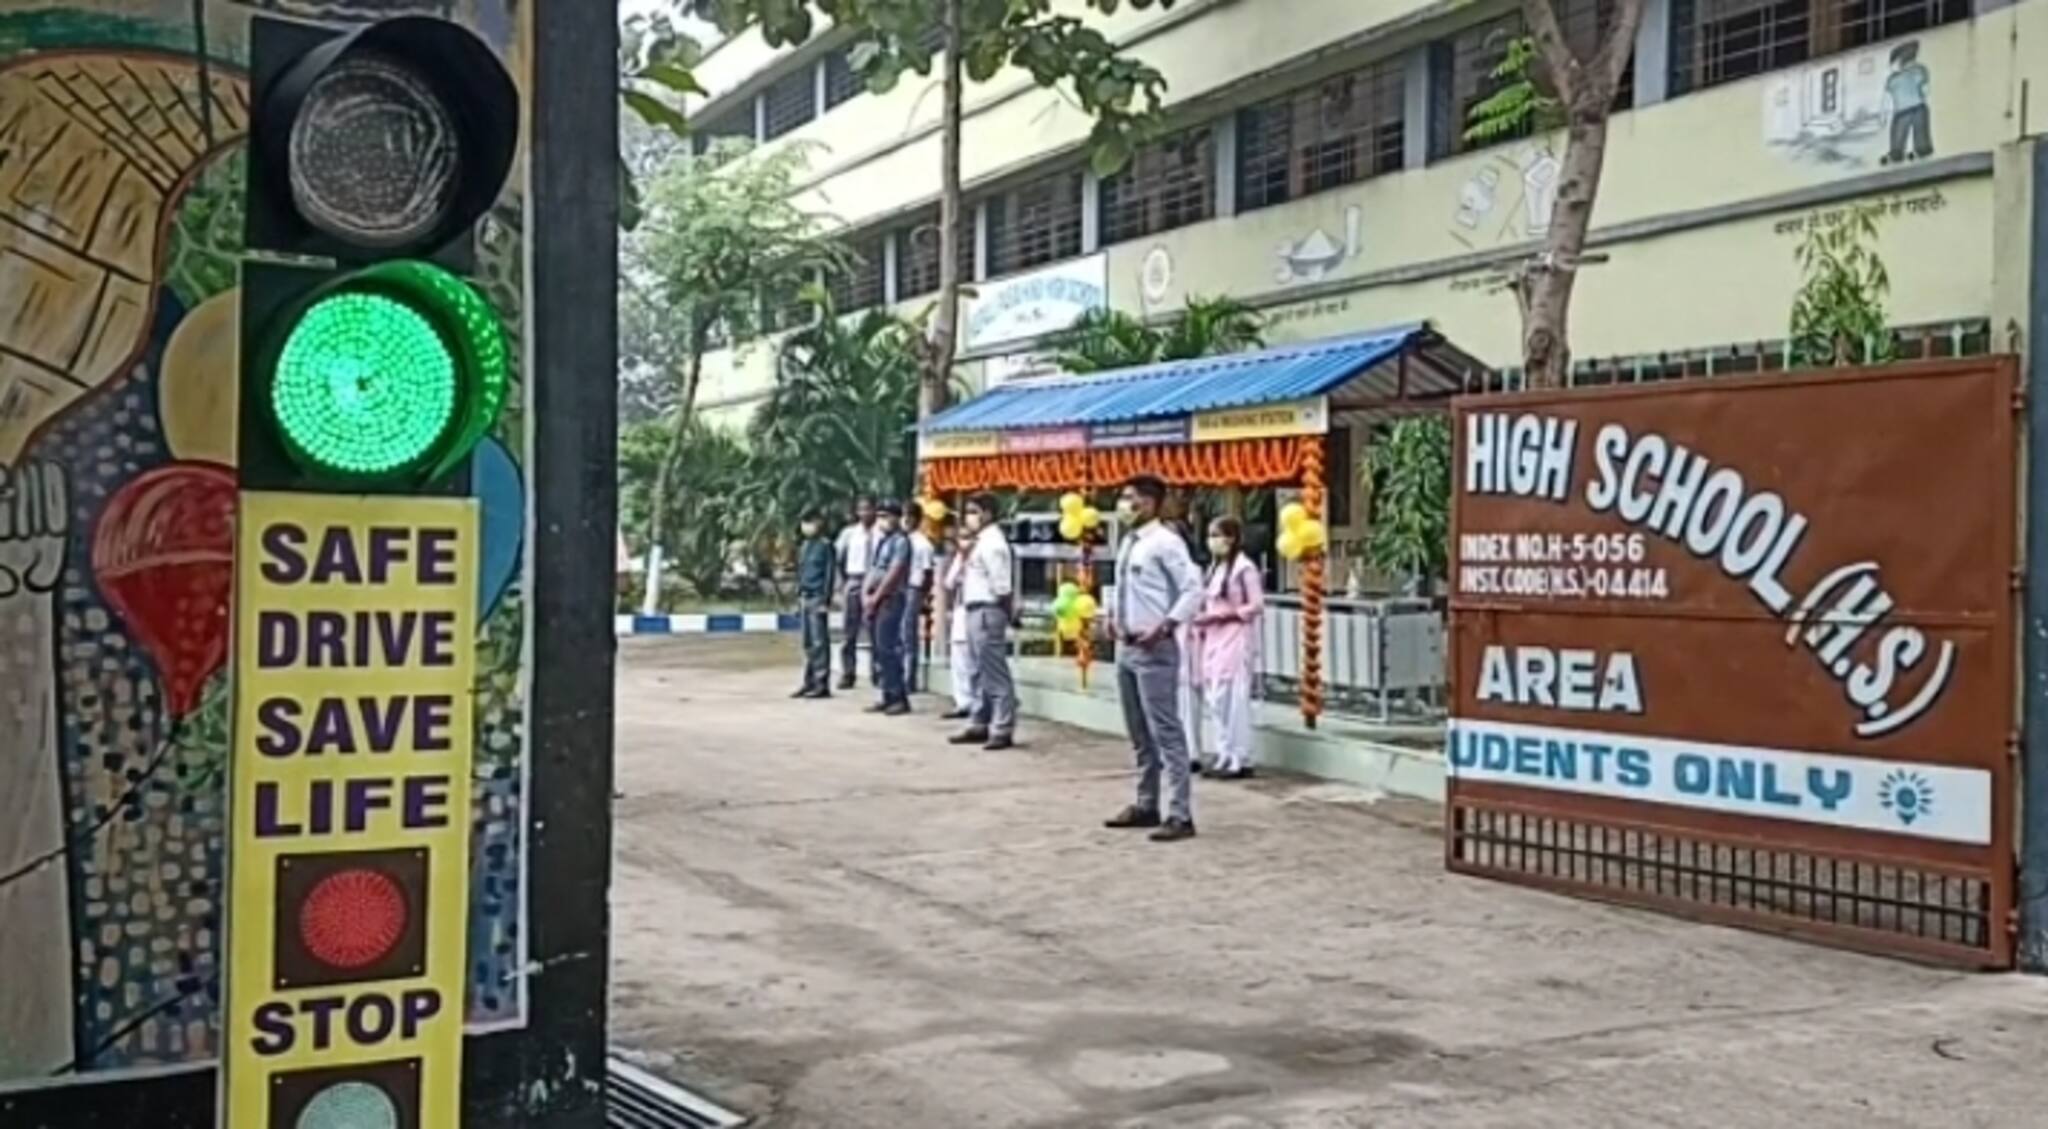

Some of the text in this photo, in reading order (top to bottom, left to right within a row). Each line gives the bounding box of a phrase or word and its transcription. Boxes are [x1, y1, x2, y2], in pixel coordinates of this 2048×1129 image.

[259, 522, 458, 586] SAFE
[1459, 533, 1512, 561] INDEX
[1466, 413, 1955, 736] HIGH SCHOOL (H.S.)
[258, 610, 455, 669] DRIVE
[1476, 645, 1643, 713] AREA
[255, 694, 453, 758] SAVE
[1449, 729, 1852, 811] UDENTS ONLY
[255, 775, 450, 838] LIFE
[251, 989, 442, 1056] STOP
